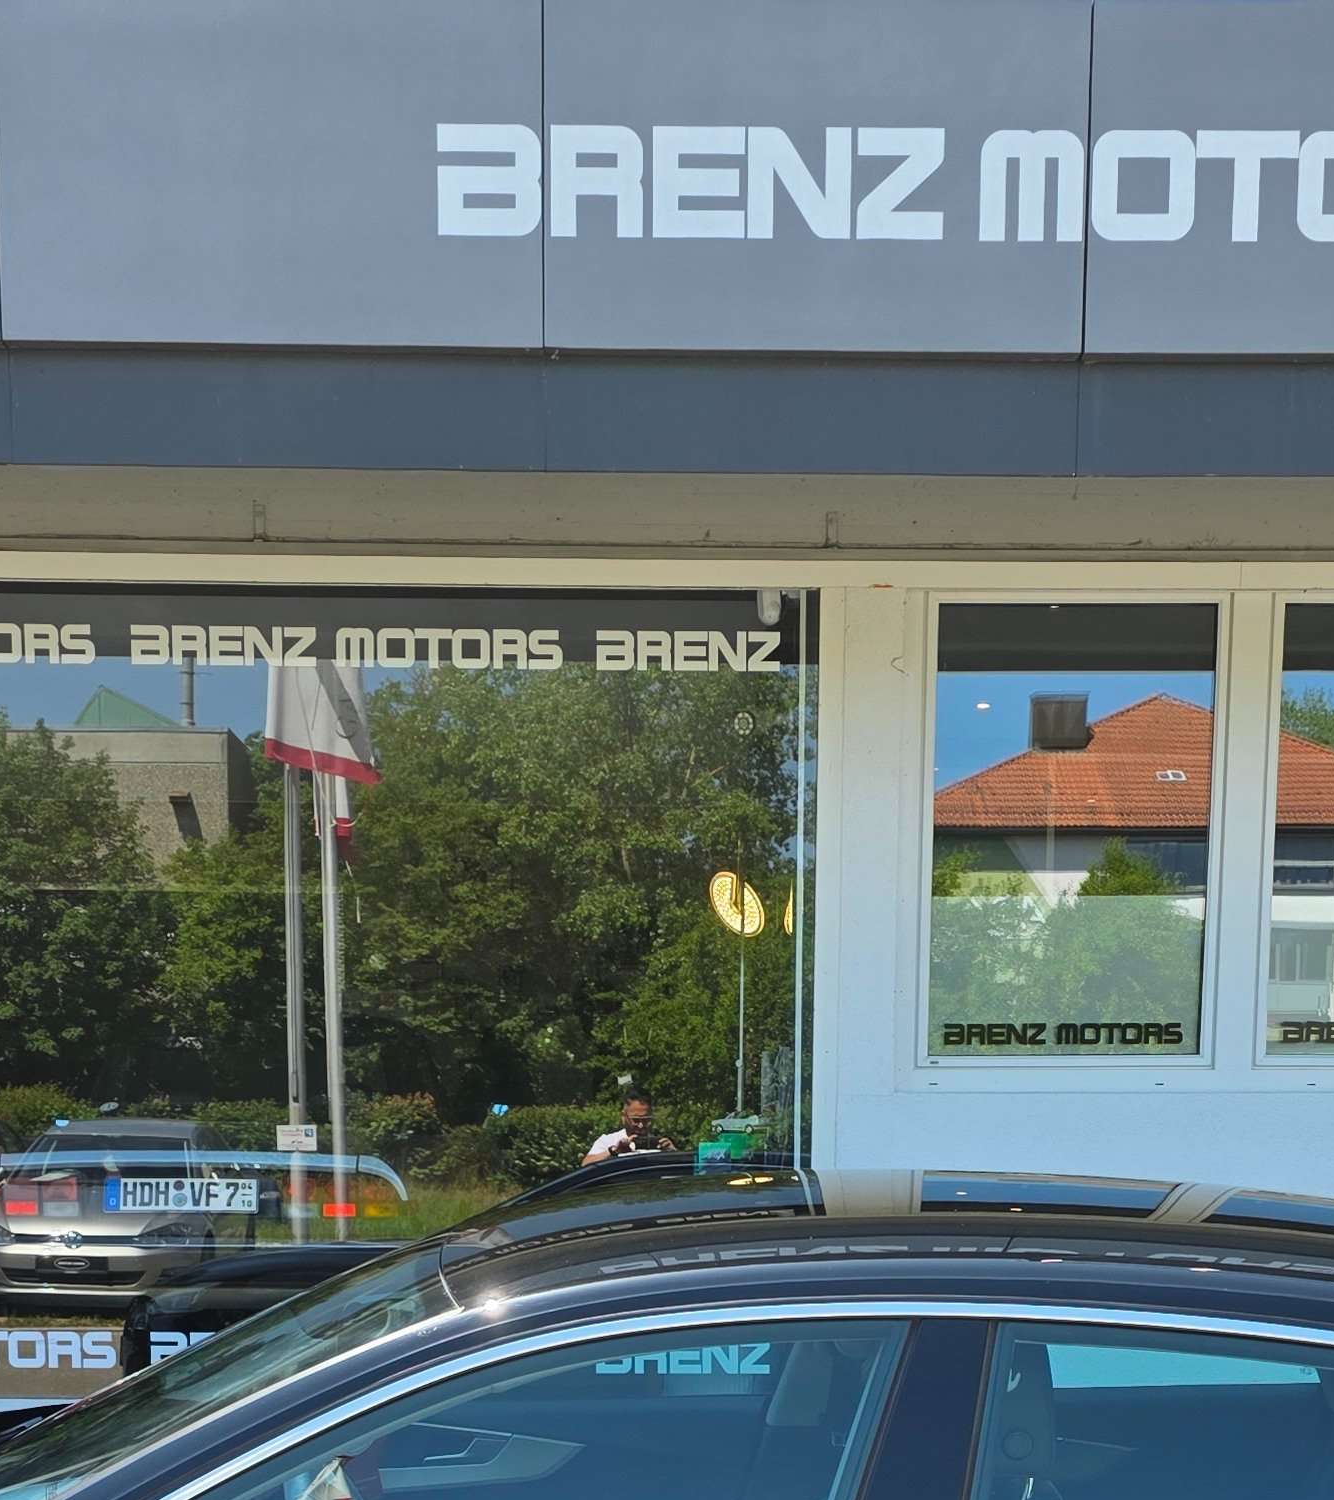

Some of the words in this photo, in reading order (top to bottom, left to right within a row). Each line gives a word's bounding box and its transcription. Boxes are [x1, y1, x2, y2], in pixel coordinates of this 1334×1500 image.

[436, 123, 945, 239] BRENZ
[130, 625, 317, 667] BRENZ
[335, 627, 563, 670] MOTORS
[596, 630, 781, 673] BRENZ
[943, 1022, 1047, 1046] BRENZ
[1057, 1022, 1184, 1046] MOTORS
[123, 1181, 170, 1208] HDH
